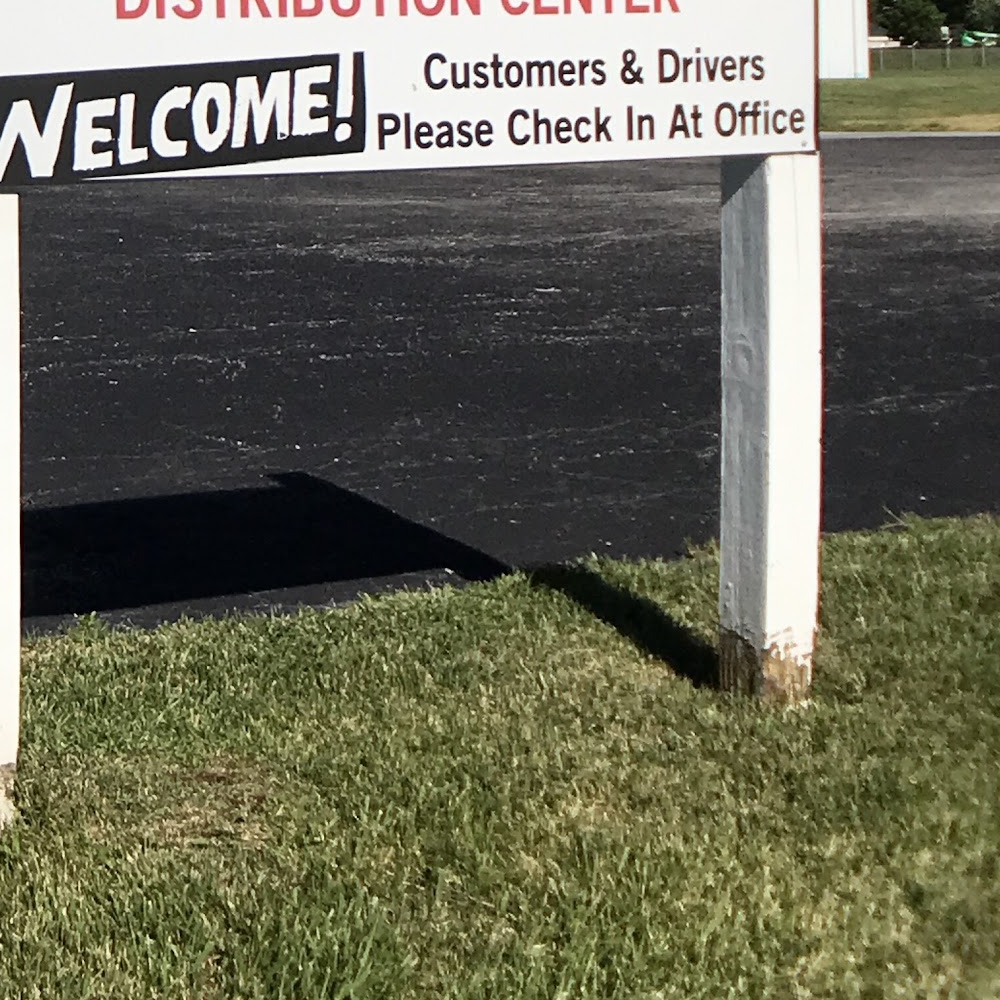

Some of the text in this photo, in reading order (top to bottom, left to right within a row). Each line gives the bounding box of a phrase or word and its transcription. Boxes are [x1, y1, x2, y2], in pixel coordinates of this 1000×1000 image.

[423, 48, 765, 90] Customers & Drivers
[377, 99, 806, 152] Please Check In At Office
